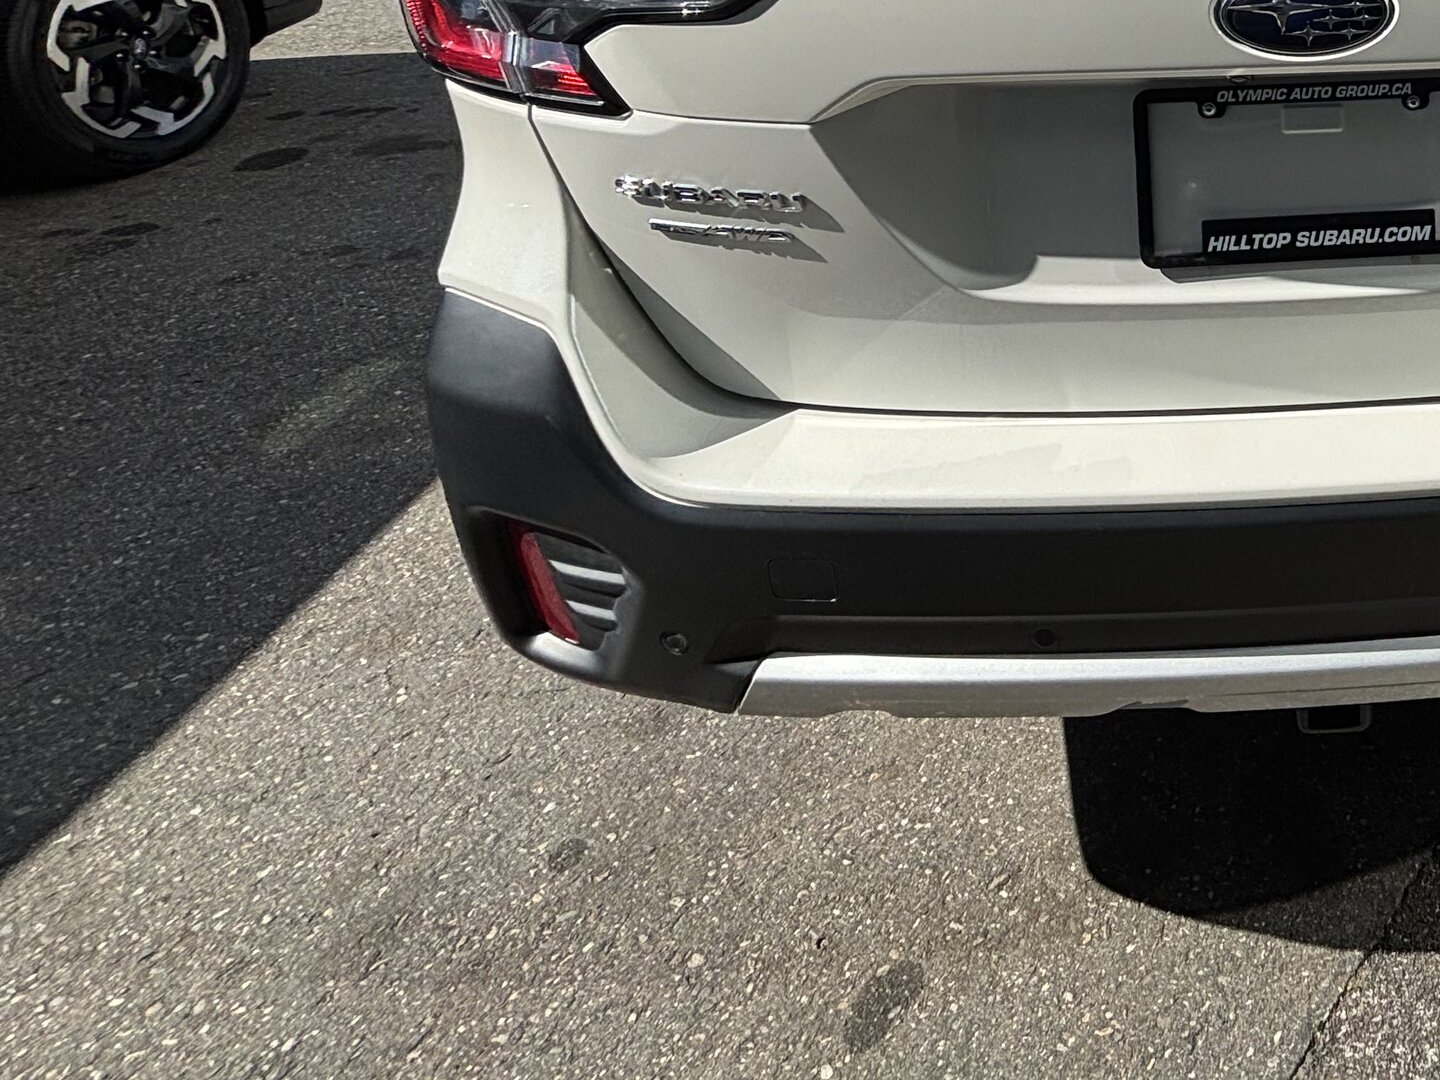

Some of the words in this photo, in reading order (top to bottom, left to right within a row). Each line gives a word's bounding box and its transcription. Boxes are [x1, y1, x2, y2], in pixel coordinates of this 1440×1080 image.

[1216, 87, 1288, 103] OLYMPIC
[1289, 85, 1333, 101] AUTO
[1335, 82, 1413, 99] GROUP.CA
[614, 173, 803, 213] SUBARU
[1207, 232, 1292, 253] HILLTOP
[1295, 225, 1432, 248] SUBARU.COM
